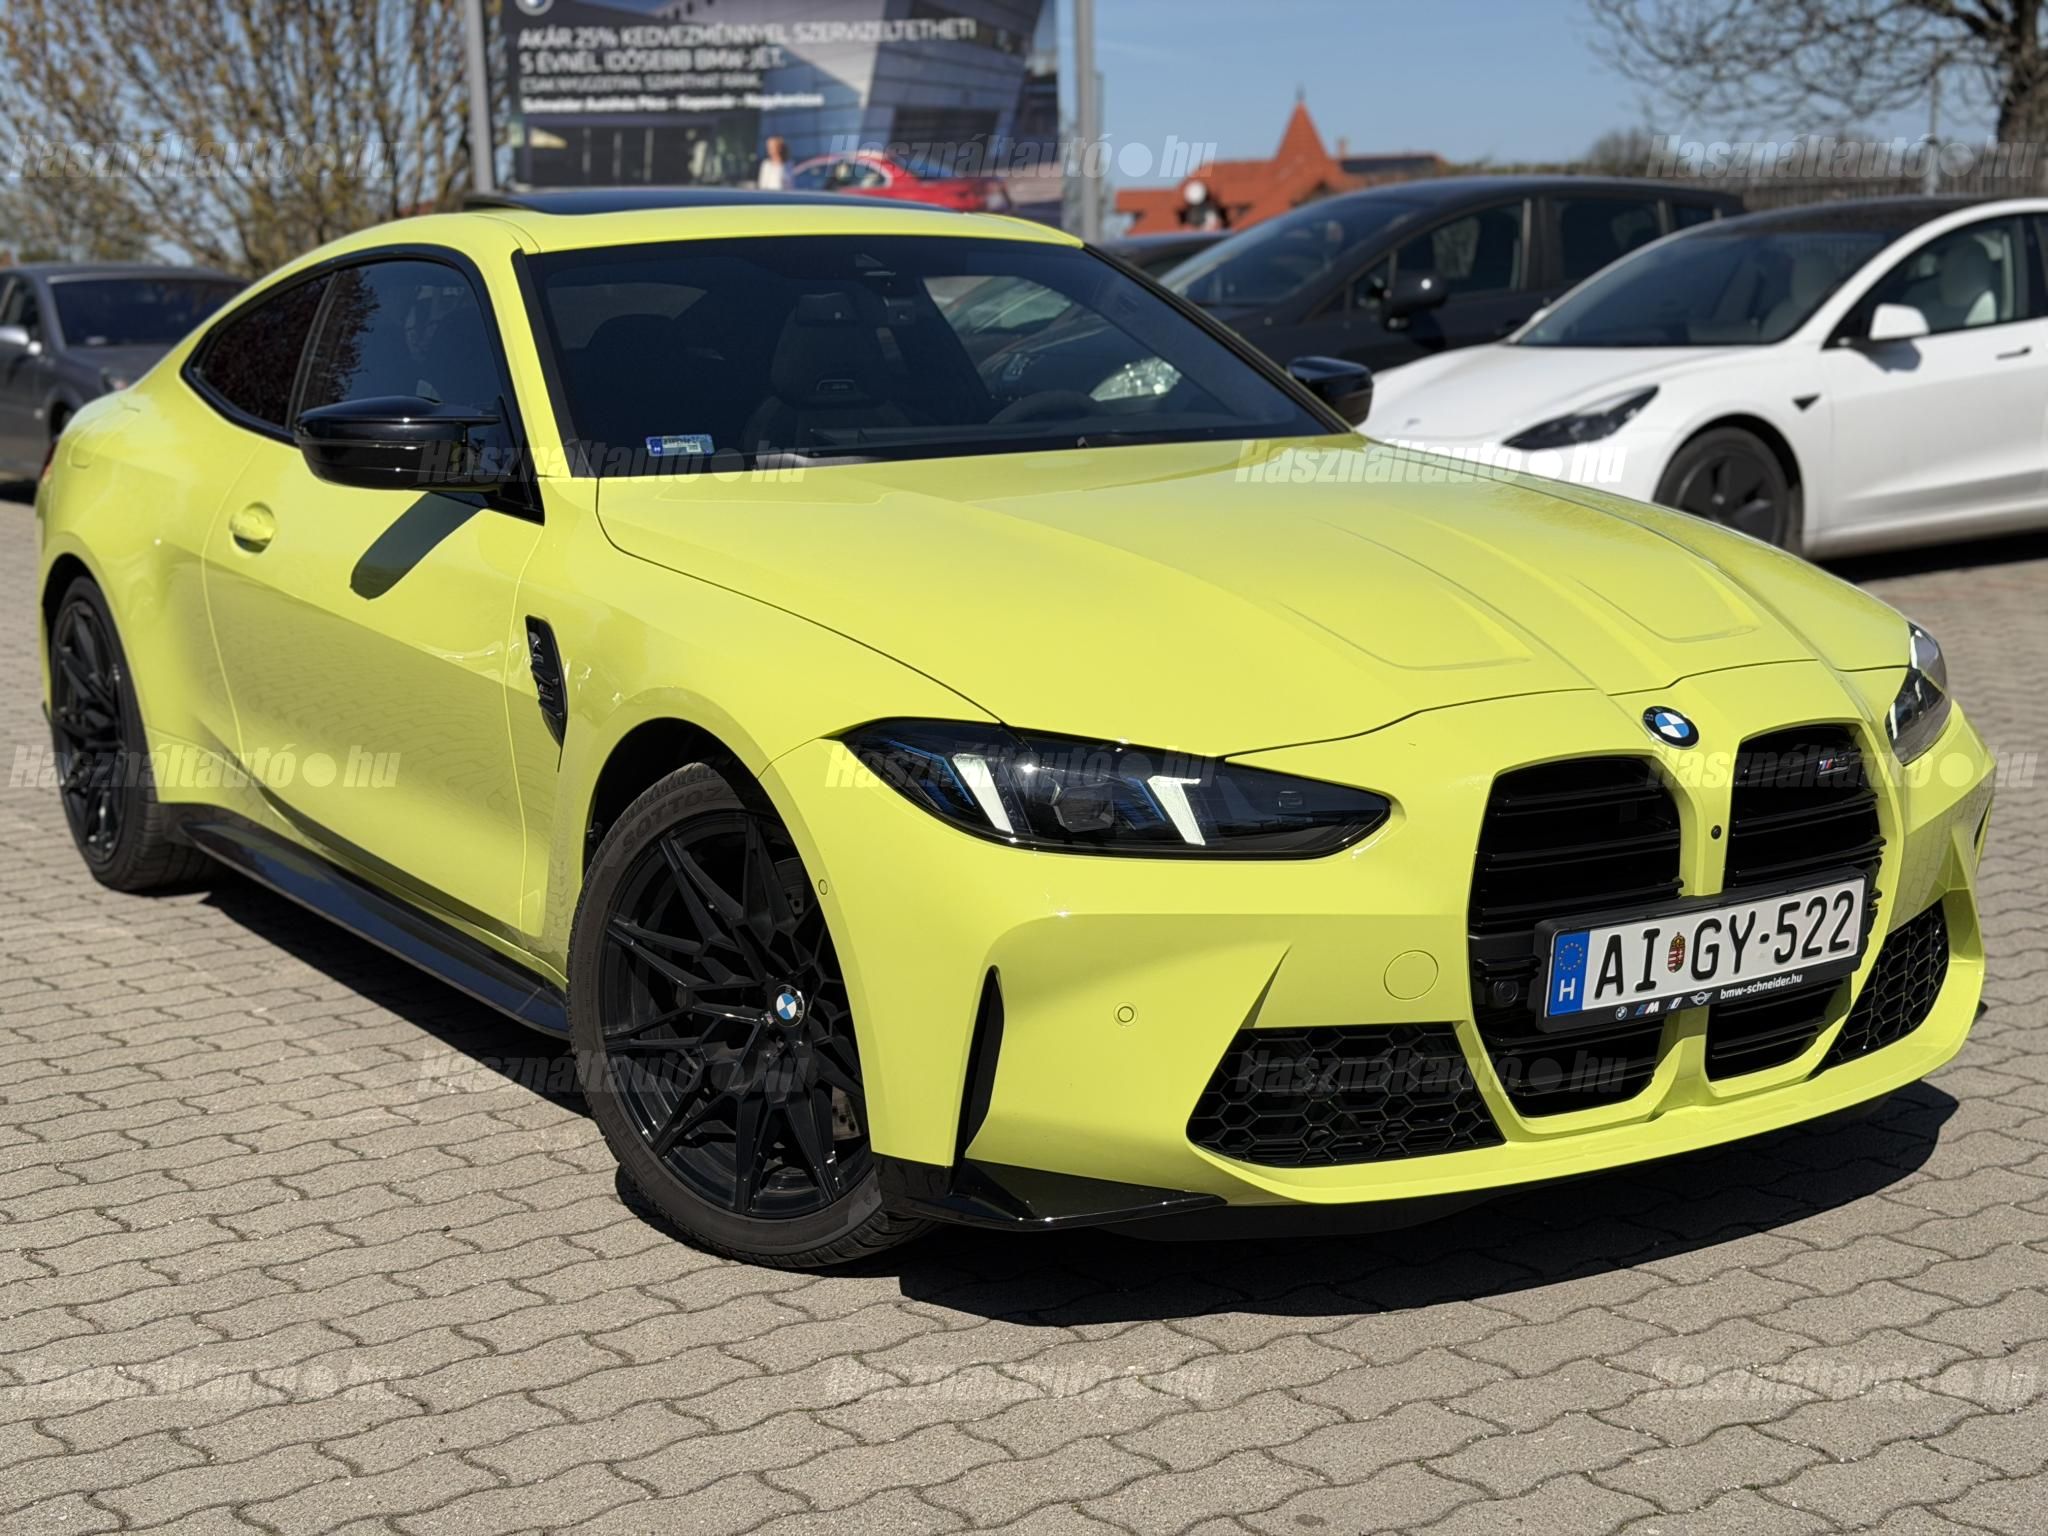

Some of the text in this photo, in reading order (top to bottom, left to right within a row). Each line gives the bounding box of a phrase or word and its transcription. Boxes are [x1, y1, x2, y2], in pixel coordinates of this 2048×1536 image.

[1594, 928, 1660, 999] AI
[1559, 977, 1575, 1002] H
[1720, 974, 1802, 999] bmw-schneider.hu
